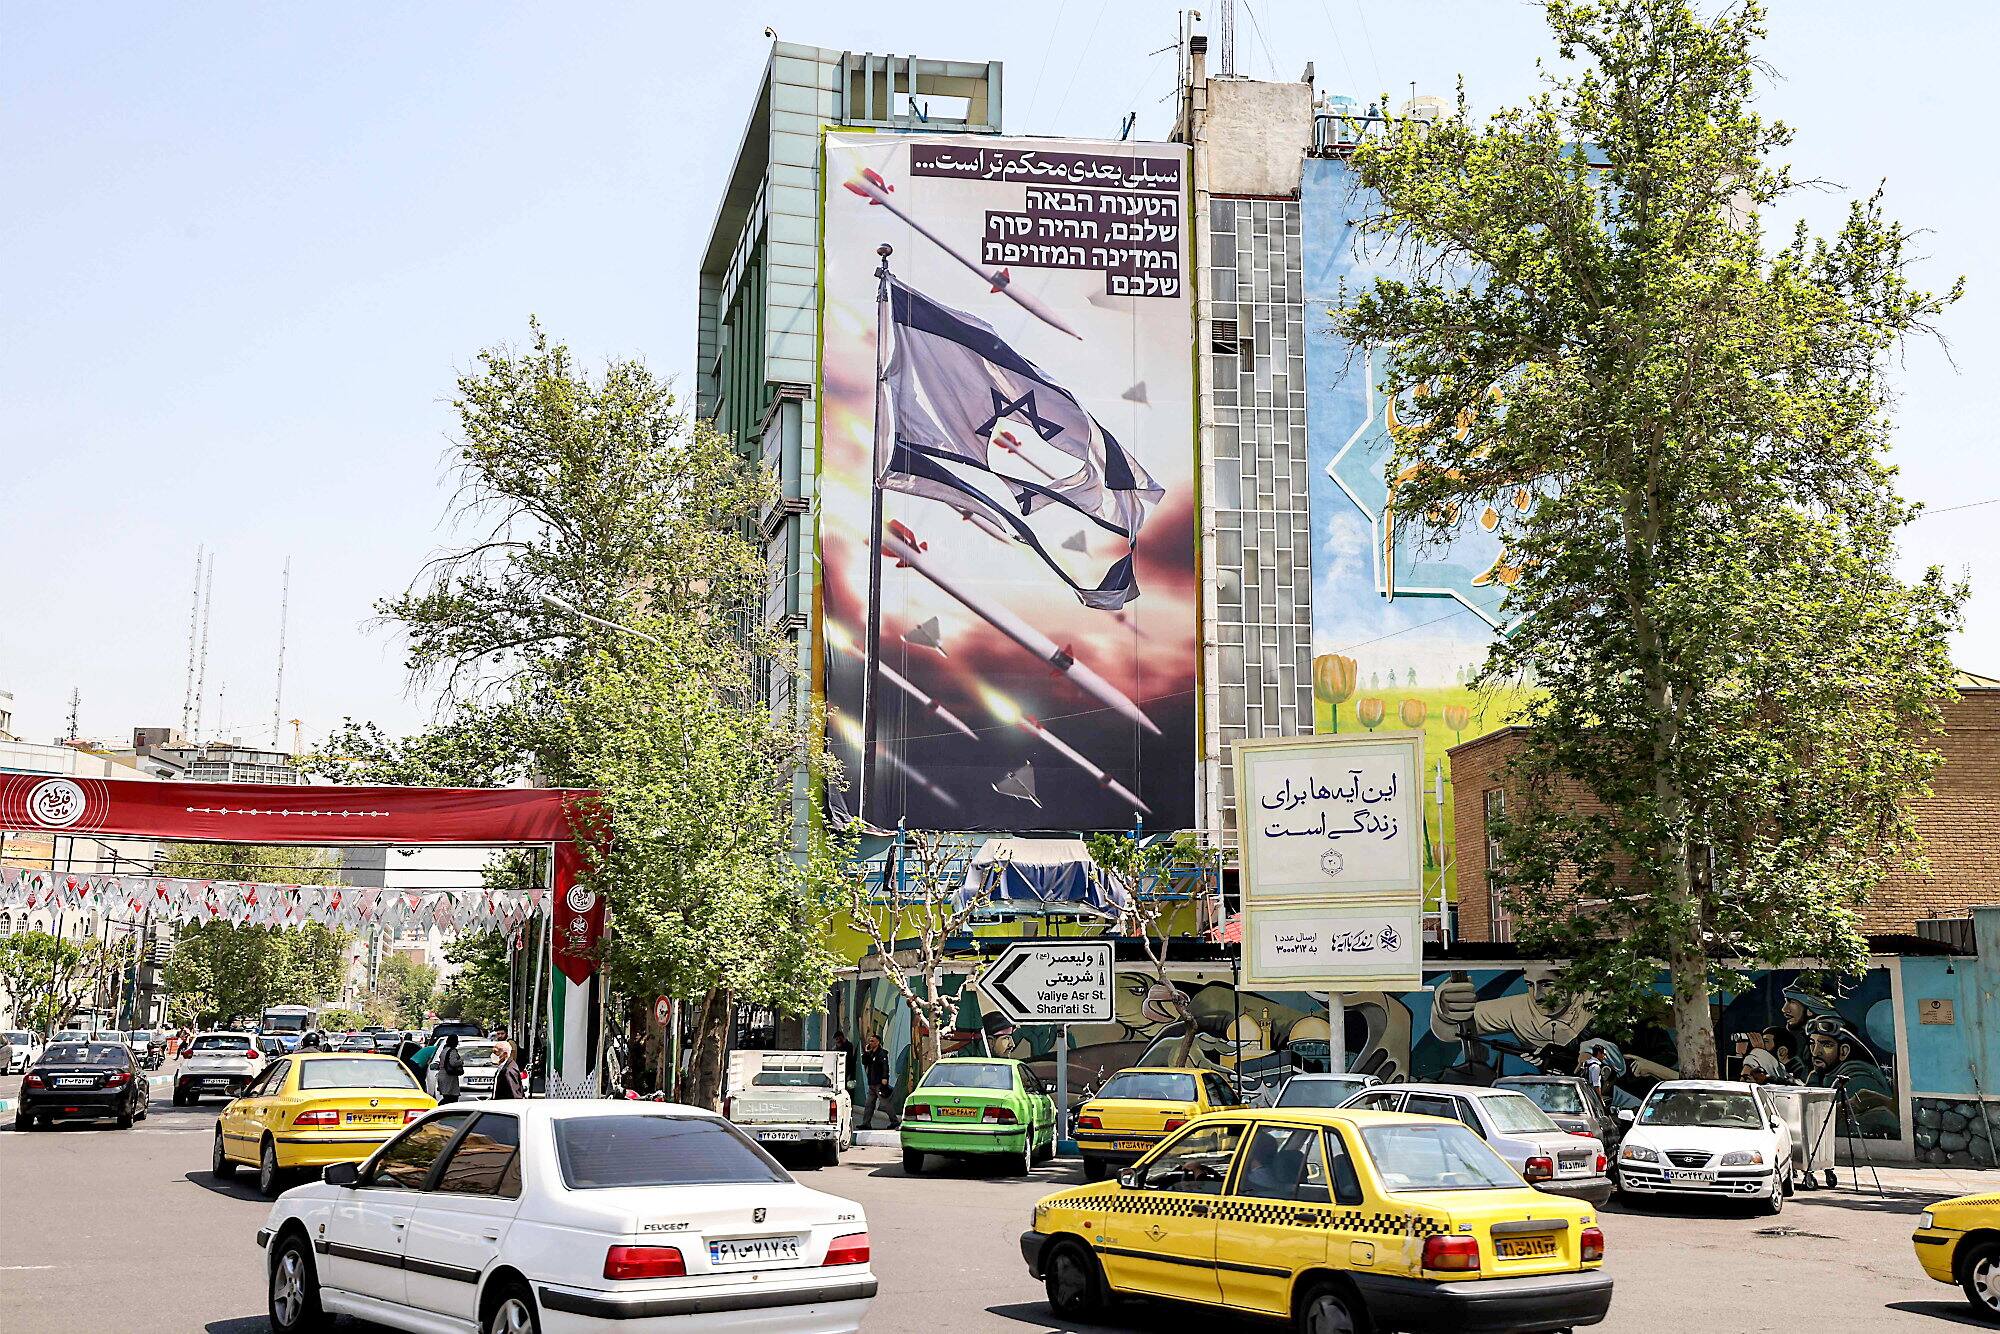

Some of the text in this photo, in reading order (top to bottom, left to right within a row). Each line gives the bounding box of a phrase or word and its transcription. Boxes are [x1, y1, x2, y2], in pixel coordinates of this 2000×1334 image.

[1068, 158, 1122, 187] بعدی
[1122, 159, 1178, 188] سیلی
[1026, 190, 1177, 217] הטעות הבאה
[989, 214, 1177, 244] שלכם, תהיה סוף
[985, 242, 1177, 269] המדינה המזויפת
[1111, 271, 1178, 295] שלכם
[1261, 778, 1306, 811] برای
[1362, 772, 1397, 803] این
[1264, 811, 1326, 838] است
[1276, 944, 1318, 955] به ۳۰۰۰۲۱۲
[1295, 932, 1317, 943] ارسال
[1048, 951, 1093, 967] ولیعصر
[1046, 970, 1093, 986] شریعتی
[1037, 990, 1106, 1002] Valiye Asr St.
[1036, 1004, 1097, 1014] Shari'ati St.
[644, 1223, 689, 1231] PEUGEOT
